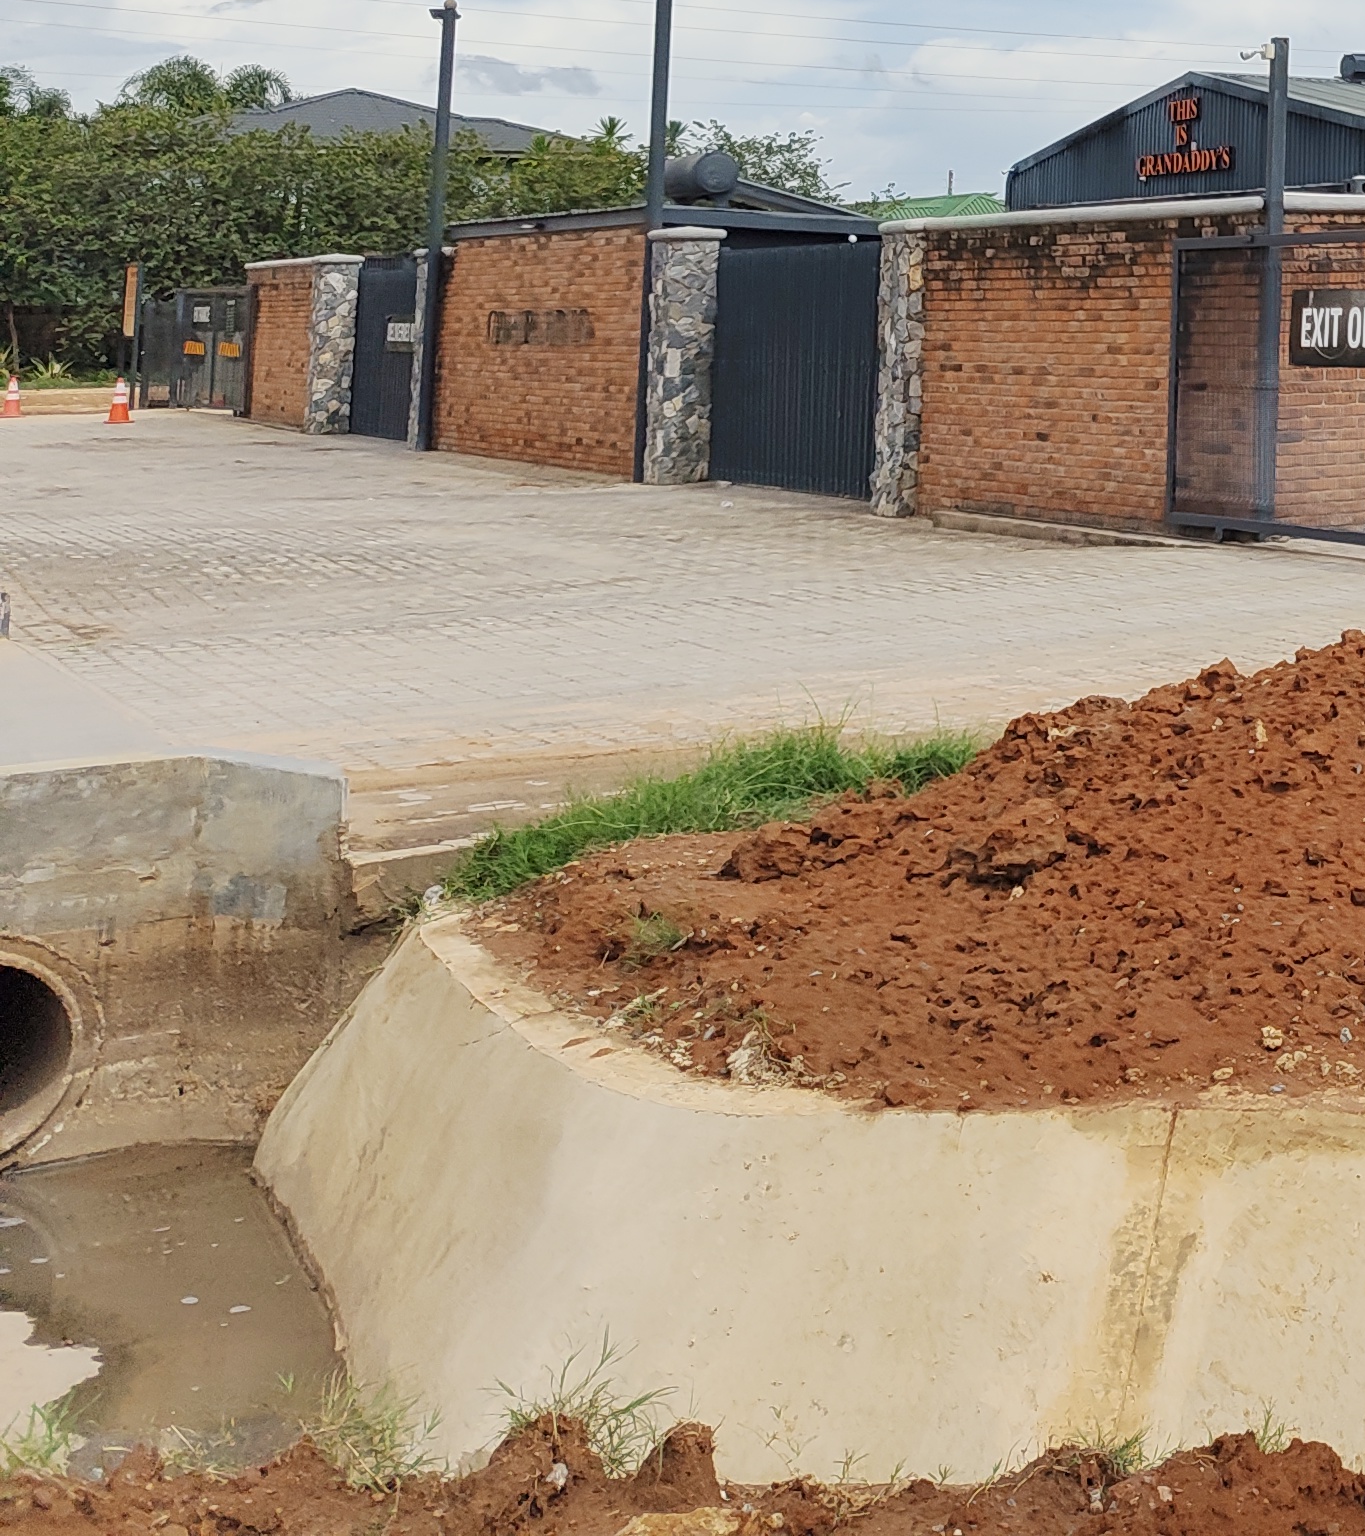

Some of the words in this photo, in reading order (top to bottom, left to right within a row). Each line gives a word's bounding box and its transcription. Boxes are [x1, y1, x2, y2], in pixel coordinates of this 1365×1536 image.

[1169, 98, 1198, 122] THIS
[1175, 124, 1188, 146] IS
[1136, 146, 1231, 177] GRANDADDY'S
[1300, 307, 1343, 348] EXIT
